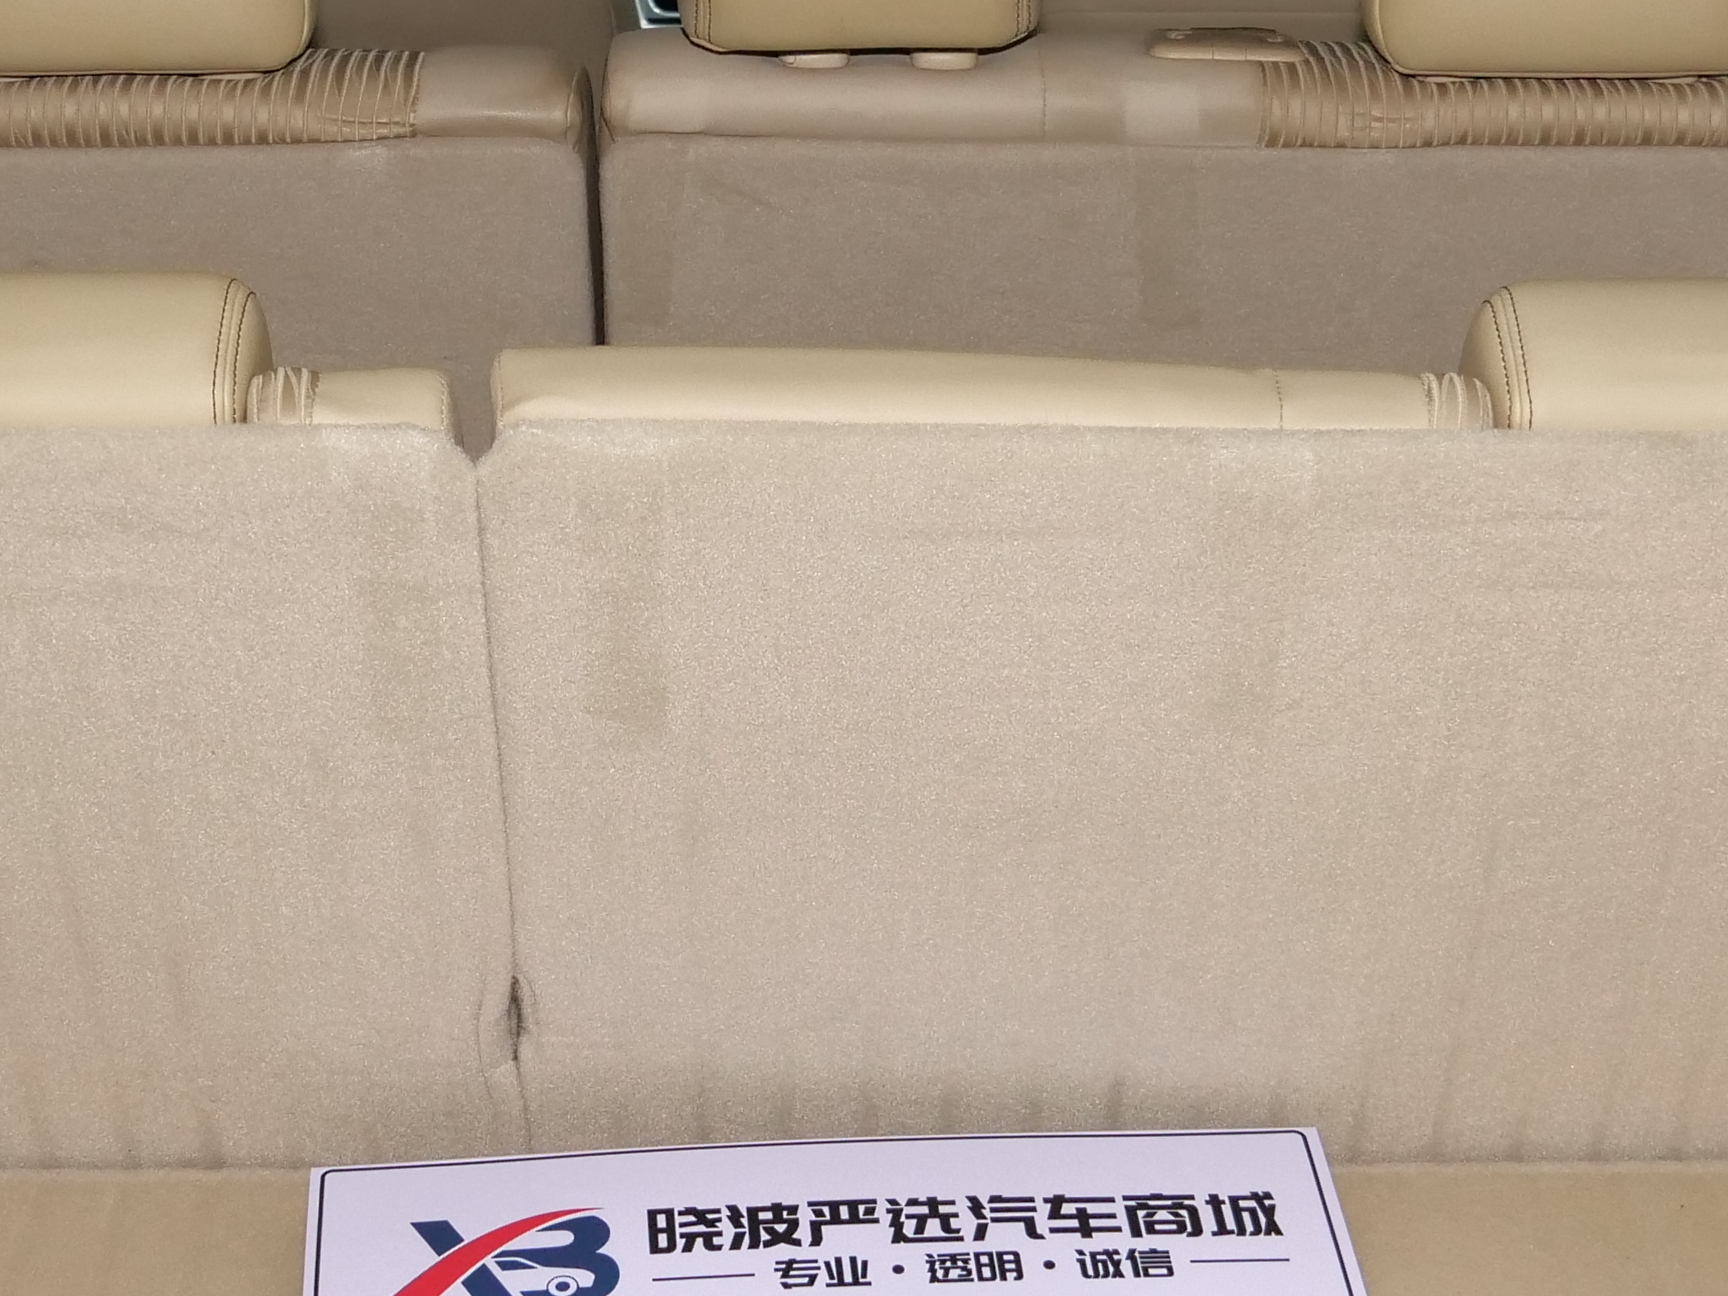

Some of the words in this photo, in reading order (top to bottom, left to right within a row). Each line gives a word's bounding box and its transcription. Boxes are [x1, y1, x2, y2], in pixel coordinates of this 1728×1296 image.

[647, 1191, 1284, 1255] 晓波严选汽车商城
